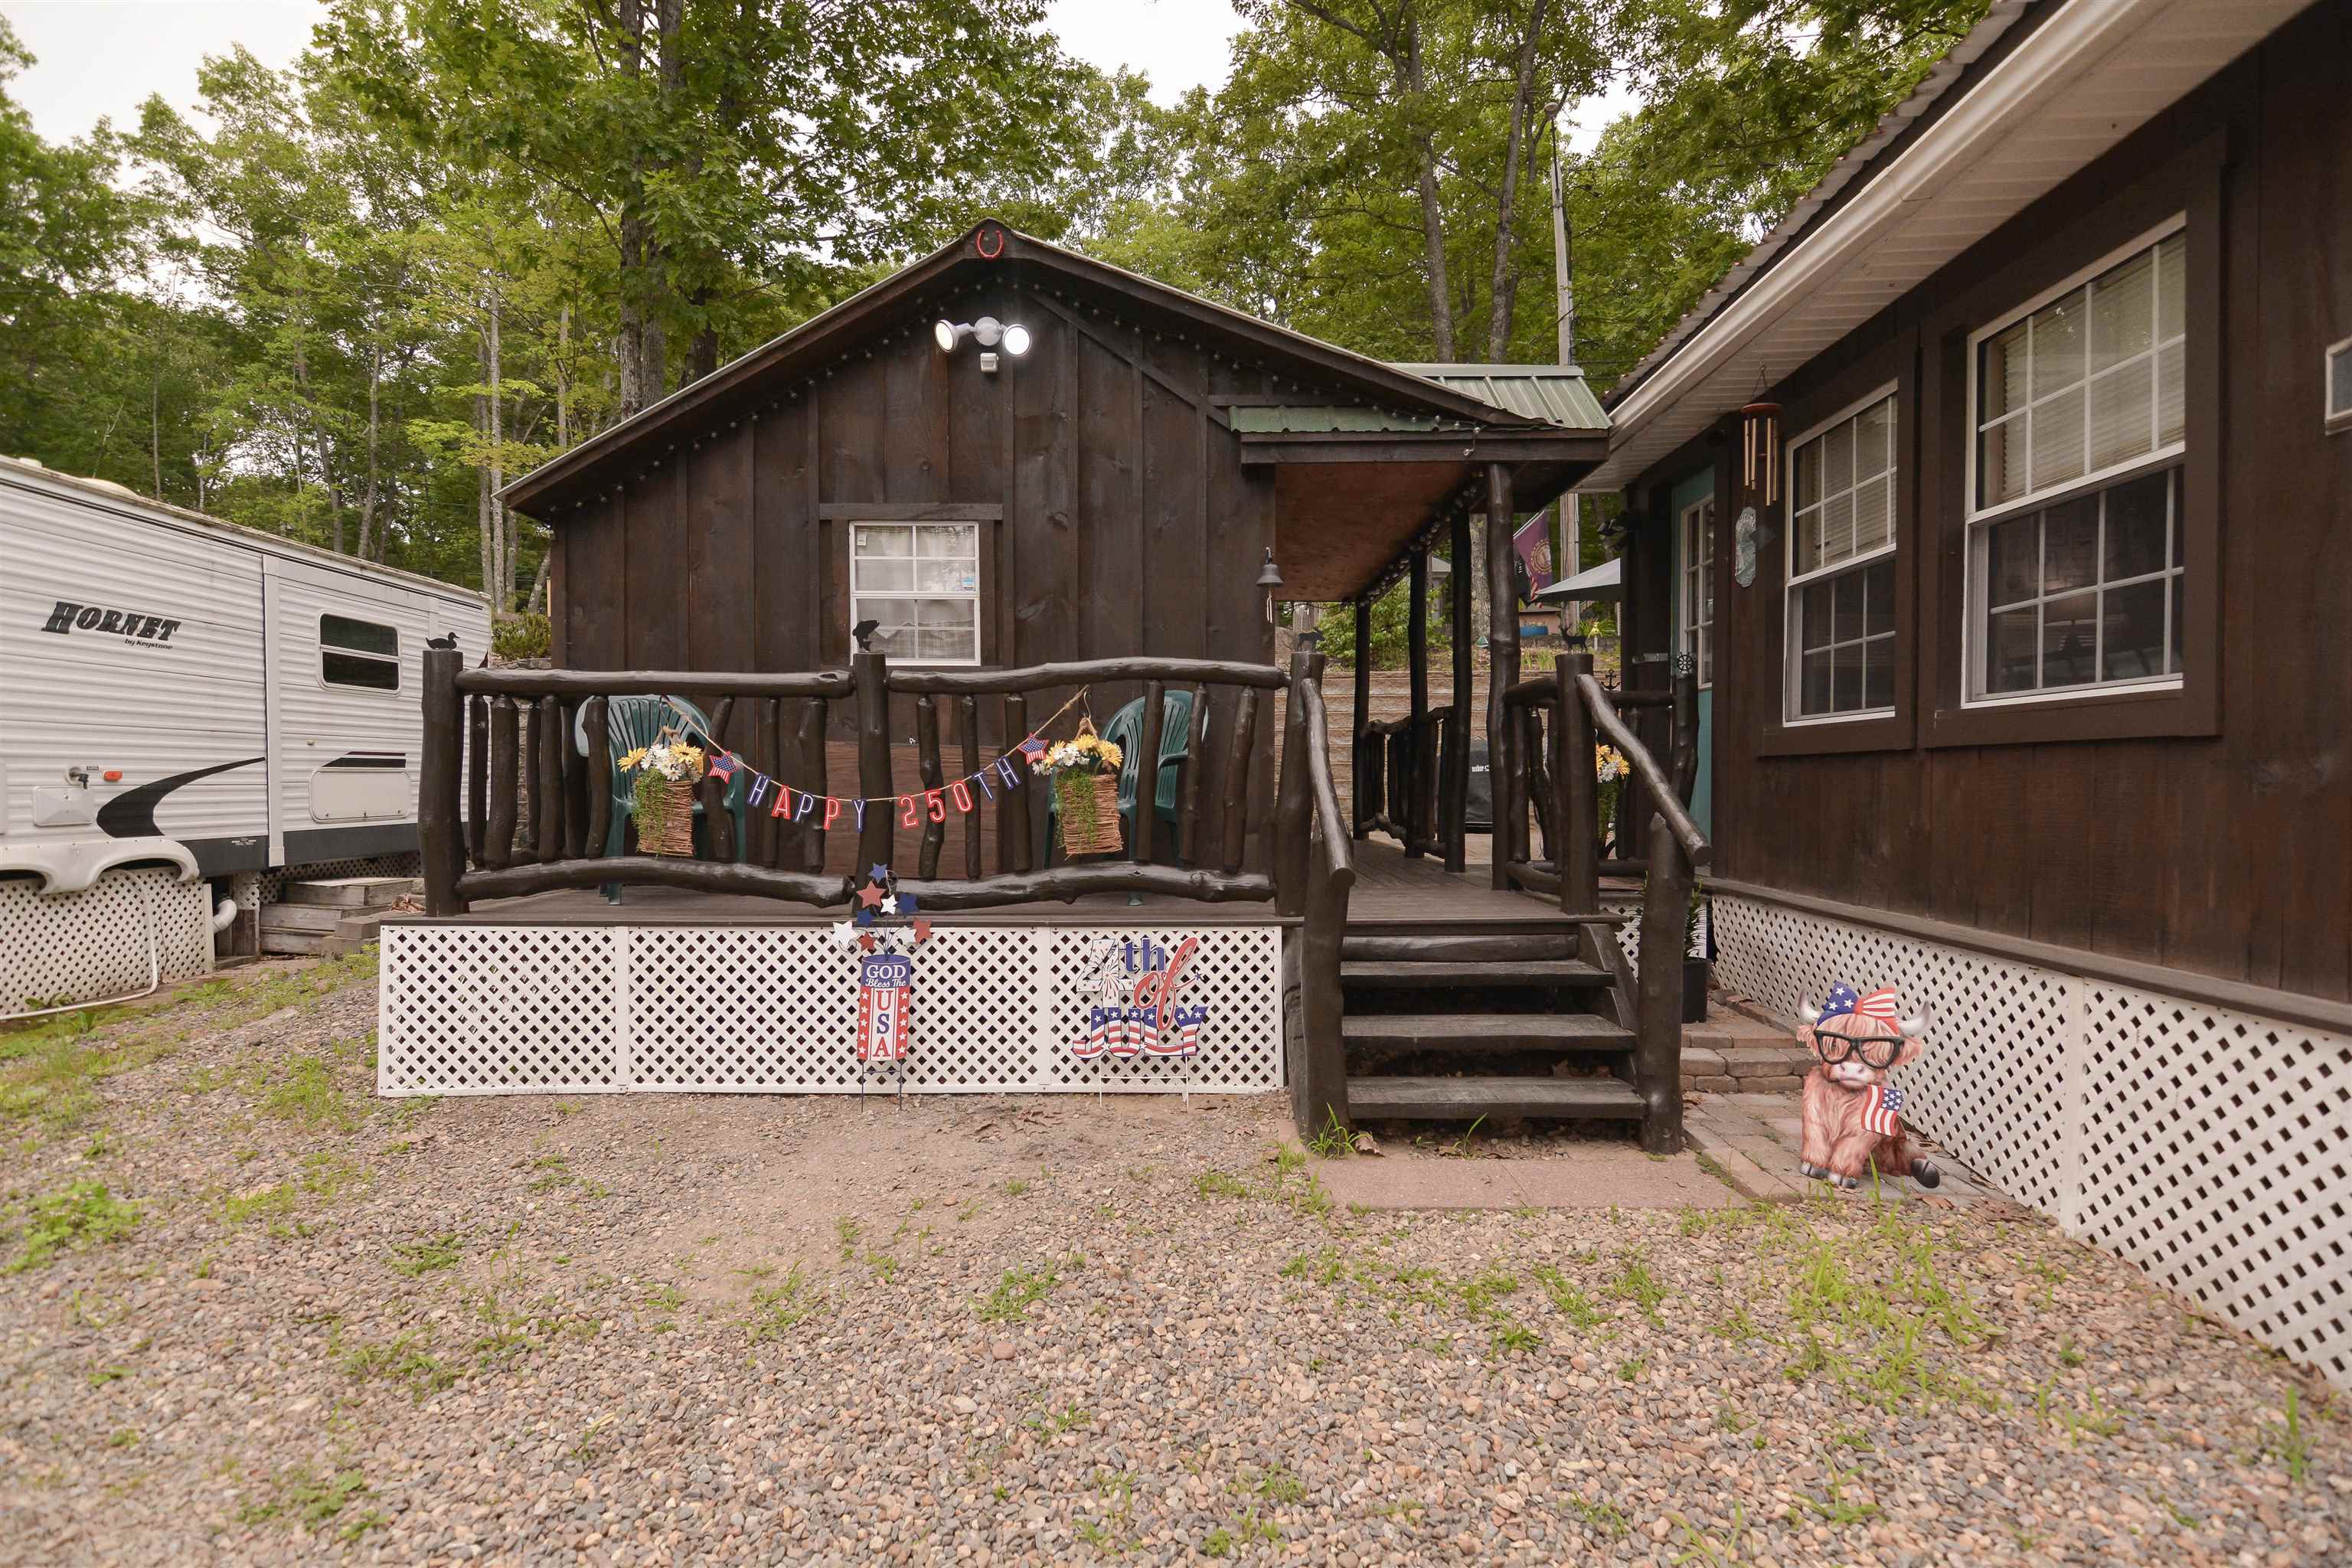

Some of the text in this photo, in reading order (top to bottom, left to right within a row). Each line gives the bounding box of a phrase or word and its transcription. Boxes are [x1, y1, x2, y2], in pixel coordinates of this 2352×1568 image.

[41, 601, 181, 641] HORNET
[136, 640, 173, 650] Keystone
[747, 756, 1022, 833] HAPPY 250TH
[865, 978, 906, 988] Bless The
[866, 965, 906, 979] GOD
[1076, 937, 1202, 1031] 4th of
[872, 990, 894, 1057] USA
[1072, 1006, 1209, 1059] JULY
